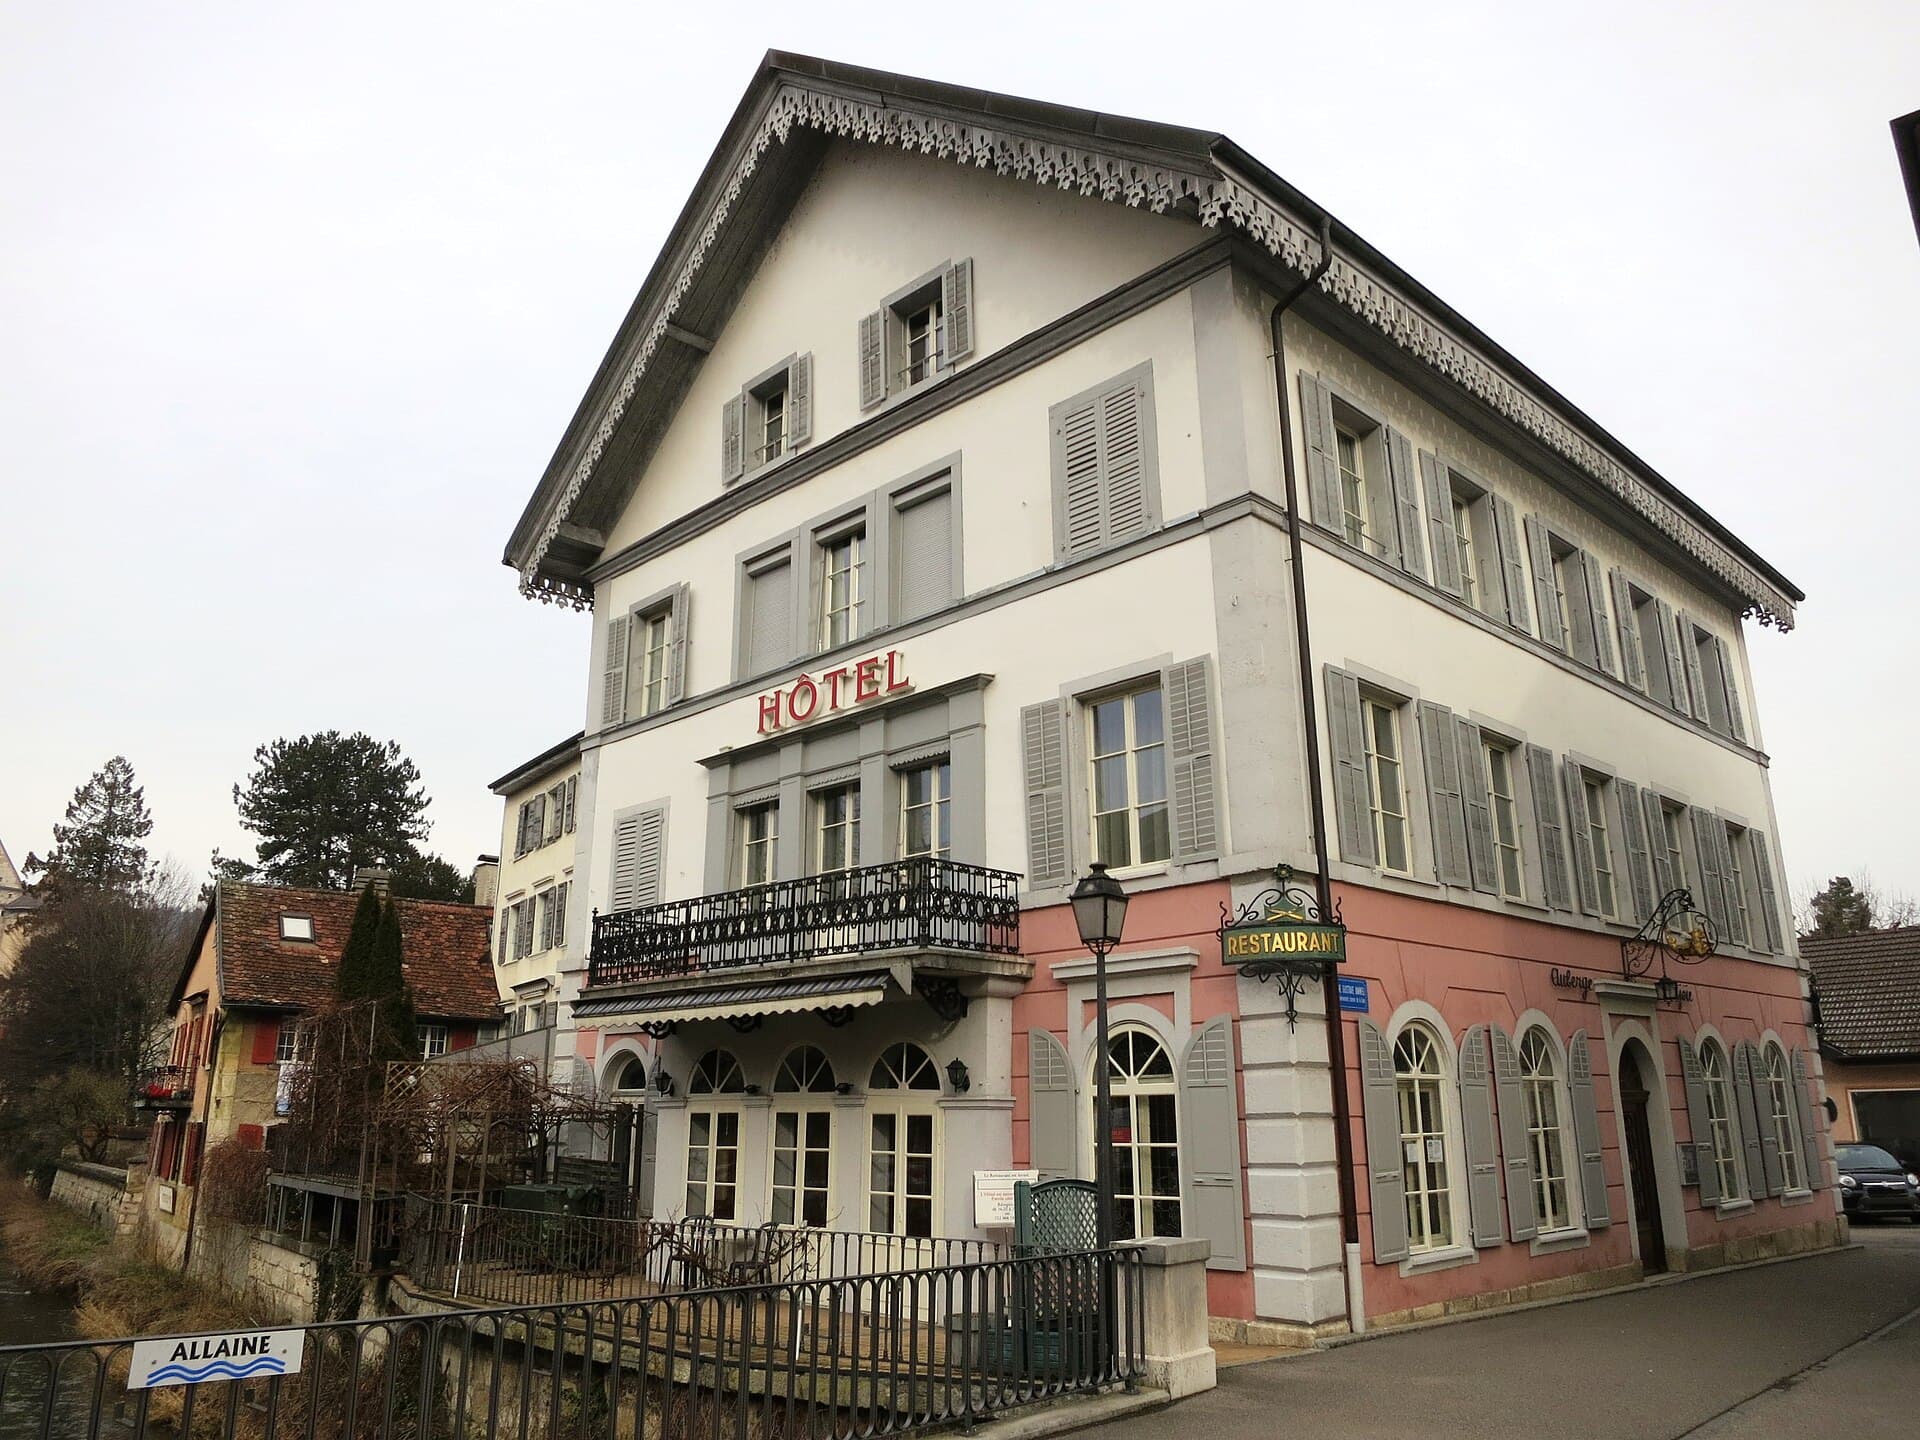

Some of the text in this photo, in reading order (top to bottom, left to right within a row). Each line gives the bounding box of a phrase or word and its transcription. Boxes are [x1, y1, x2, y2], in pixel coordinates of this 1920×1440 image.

[757, 650, 911, 734] HÔTEL
[1228, 931, 1339, 956] RESTAURANT
[1551, 967, 1593, 1000] Auberge
[169, 1335, 271, 1362] ALLAINE
